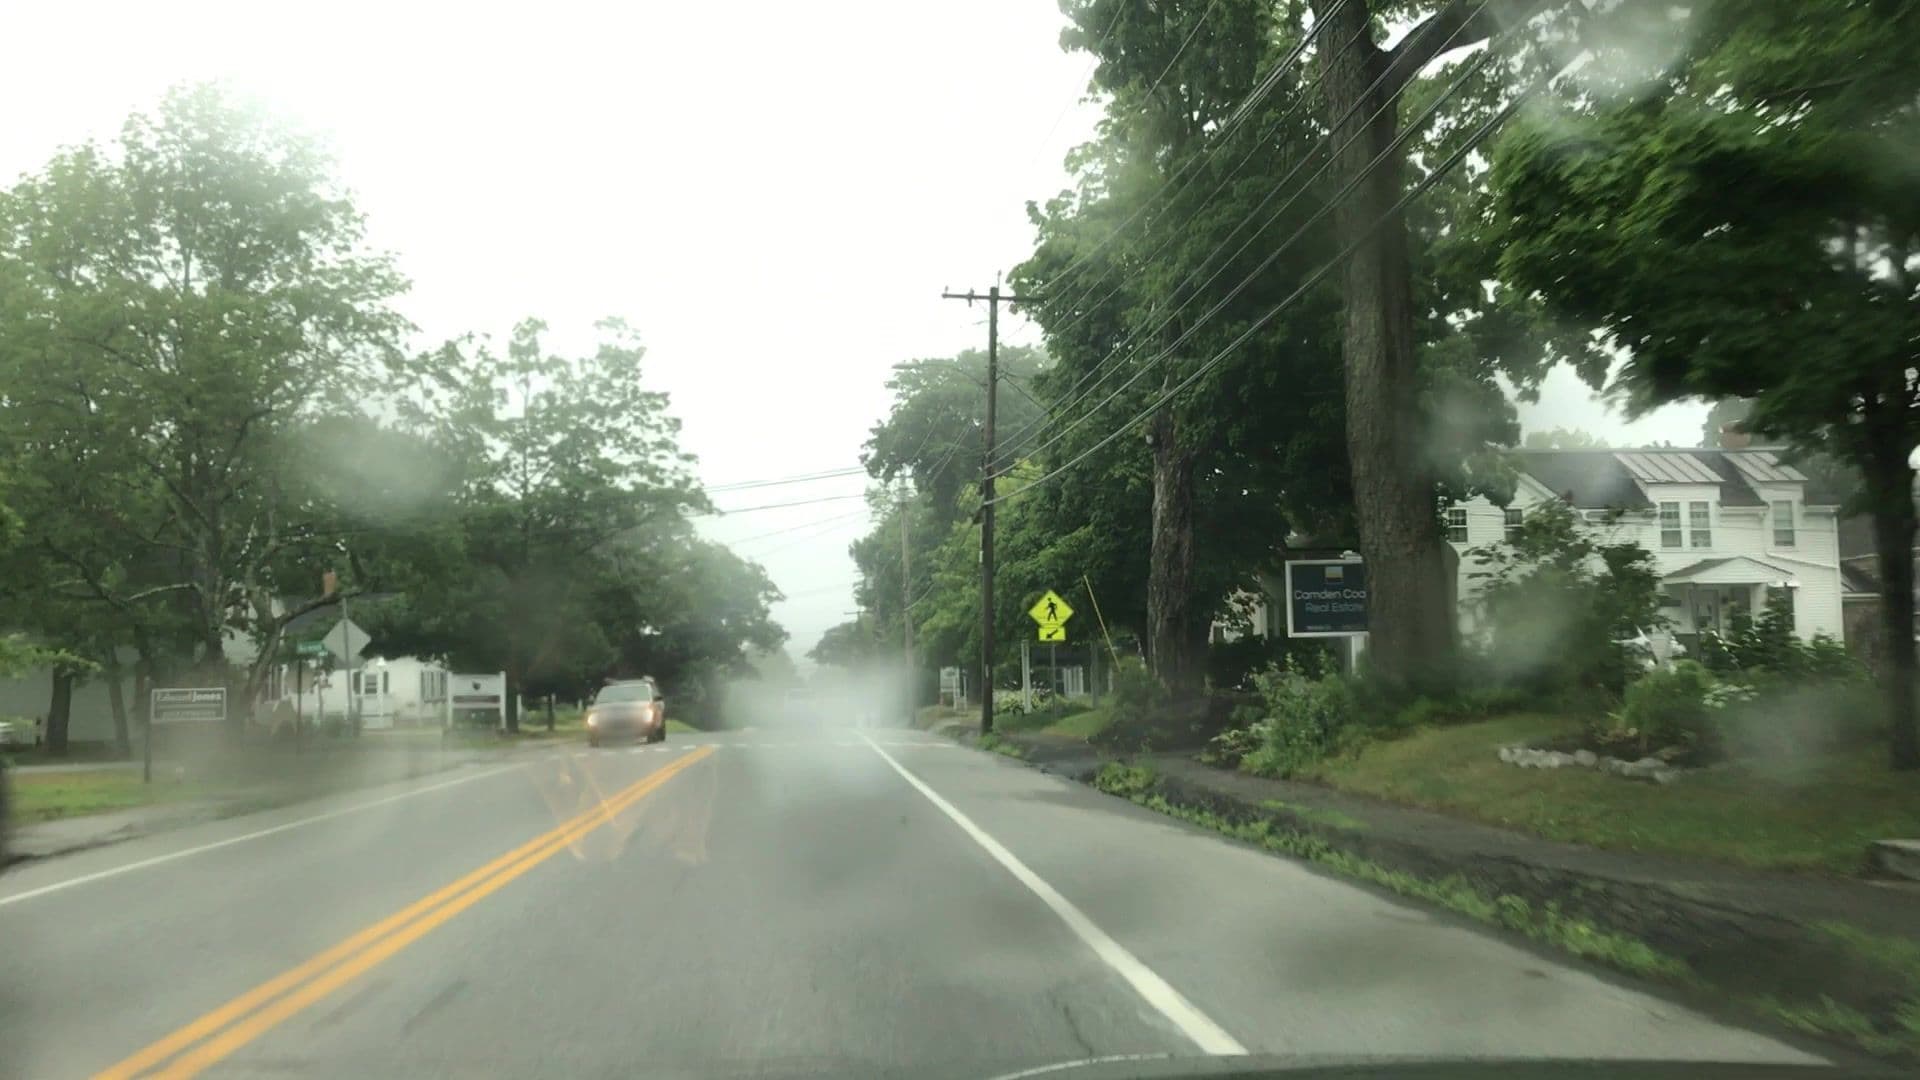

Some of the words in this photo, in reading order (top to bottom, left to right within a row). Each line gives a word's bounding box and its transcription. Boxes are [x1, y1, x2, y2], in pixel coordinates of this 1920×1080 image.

[1295, 588, 1341, 600] Camden
[1343, 588, 1367, 599] Coa
[1305, 602, 1329, 613] Real
